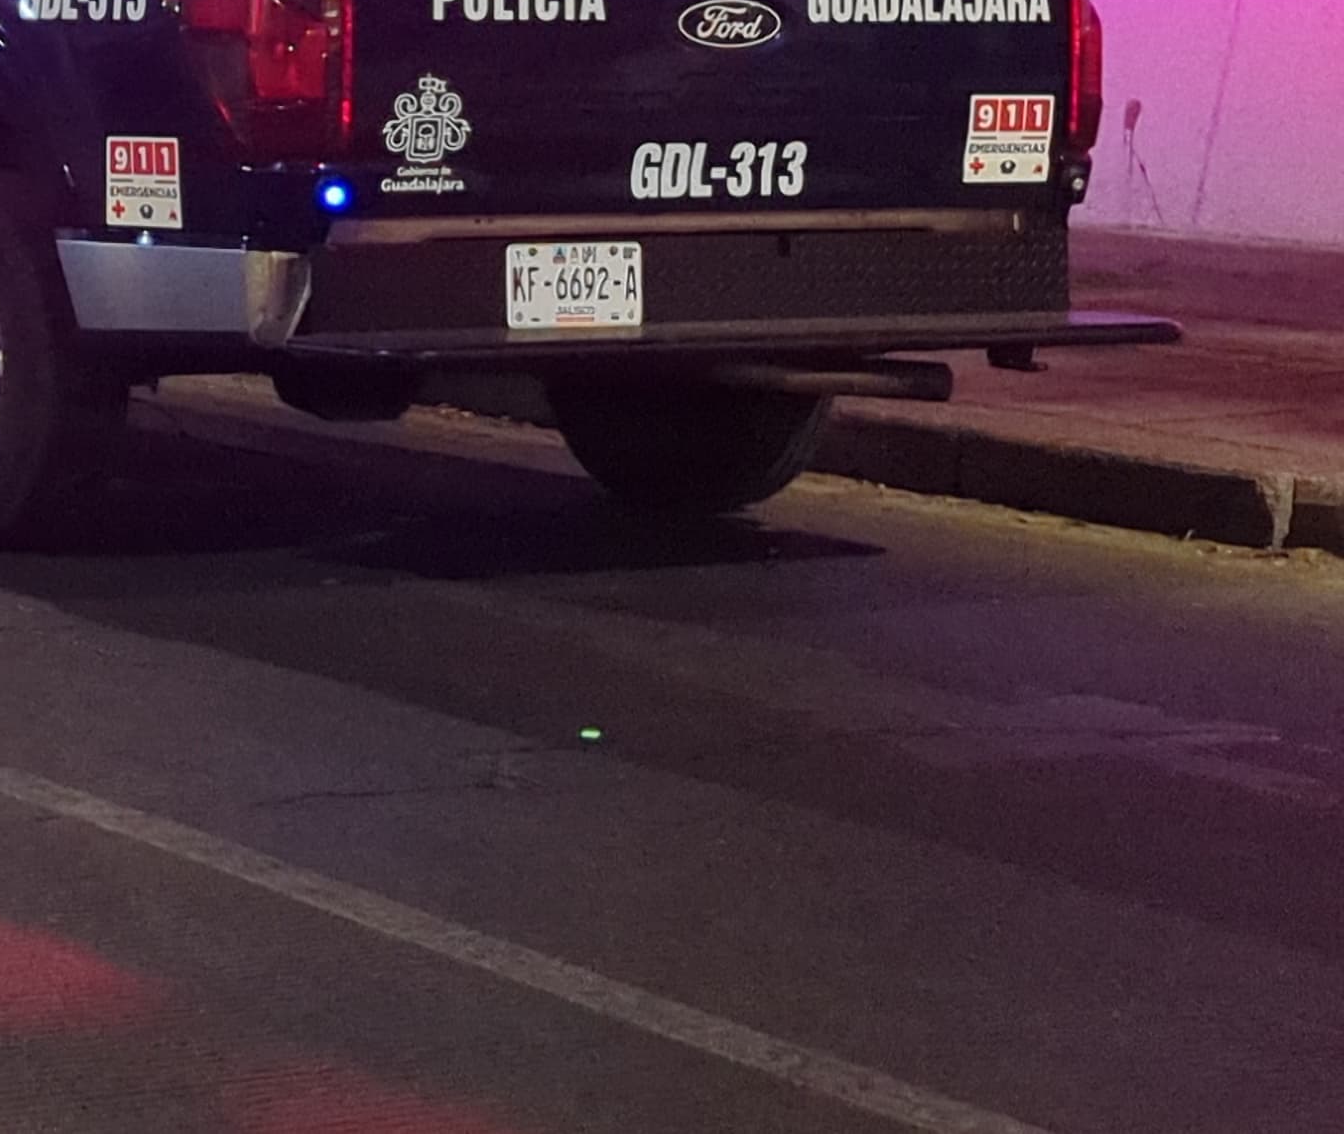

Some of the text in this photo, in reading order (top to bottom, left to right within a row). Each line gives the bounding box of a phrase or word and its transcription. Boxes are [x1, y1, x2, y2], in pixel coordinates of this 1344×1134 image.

[696, 4, 764, 40] Ford
[978, 104, 1042, 128] 911
[114, 146, 170, 171] 911
[630, 140, 808, 199] GDL-313
[381, 177, 465, 194] Guadalajara
[513, 265, 637, 302] KF-6692-A
